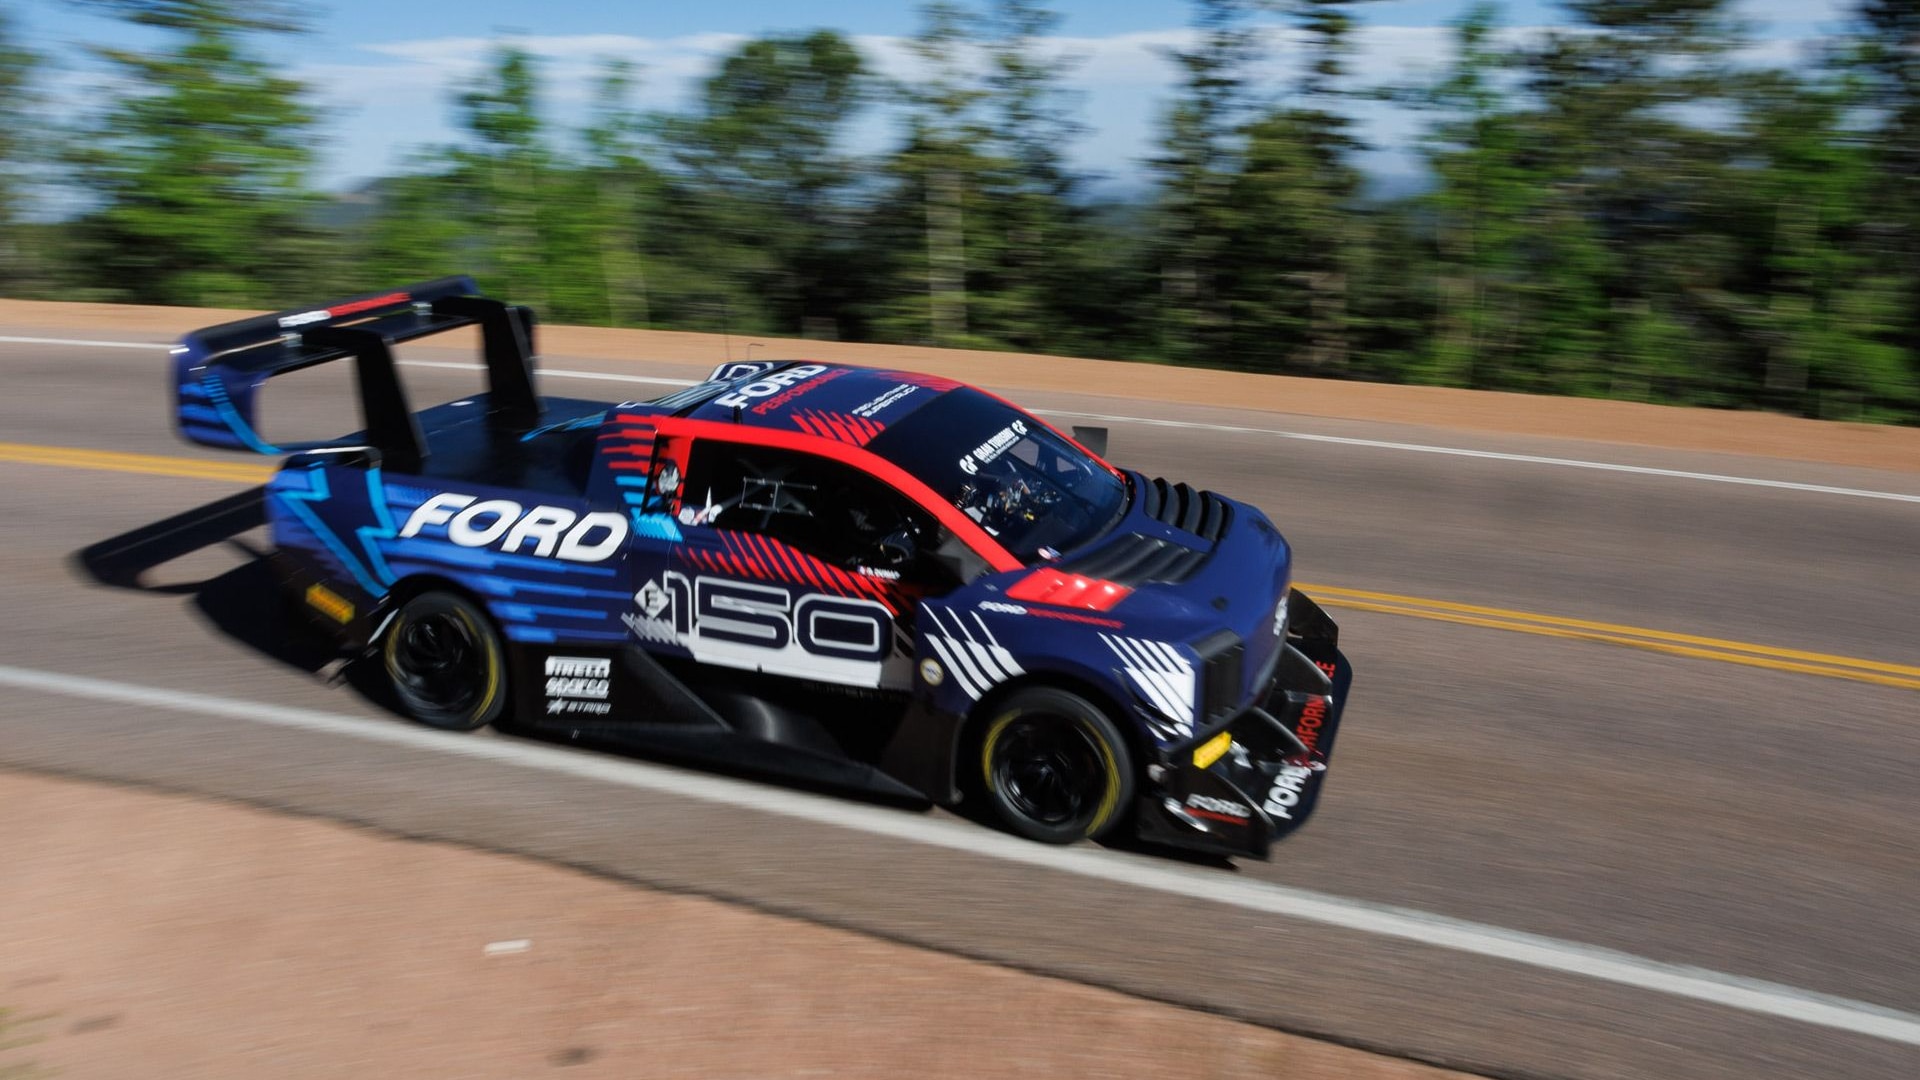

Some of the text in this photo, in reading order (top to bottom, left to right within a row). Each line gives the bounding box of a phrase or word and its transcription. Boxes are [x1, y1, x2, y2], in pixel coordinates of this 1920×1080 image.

[714, 364, 828, 410] FORD
[399, 492, 629, 563] FORD
[663, 570, 895, 663] 150
